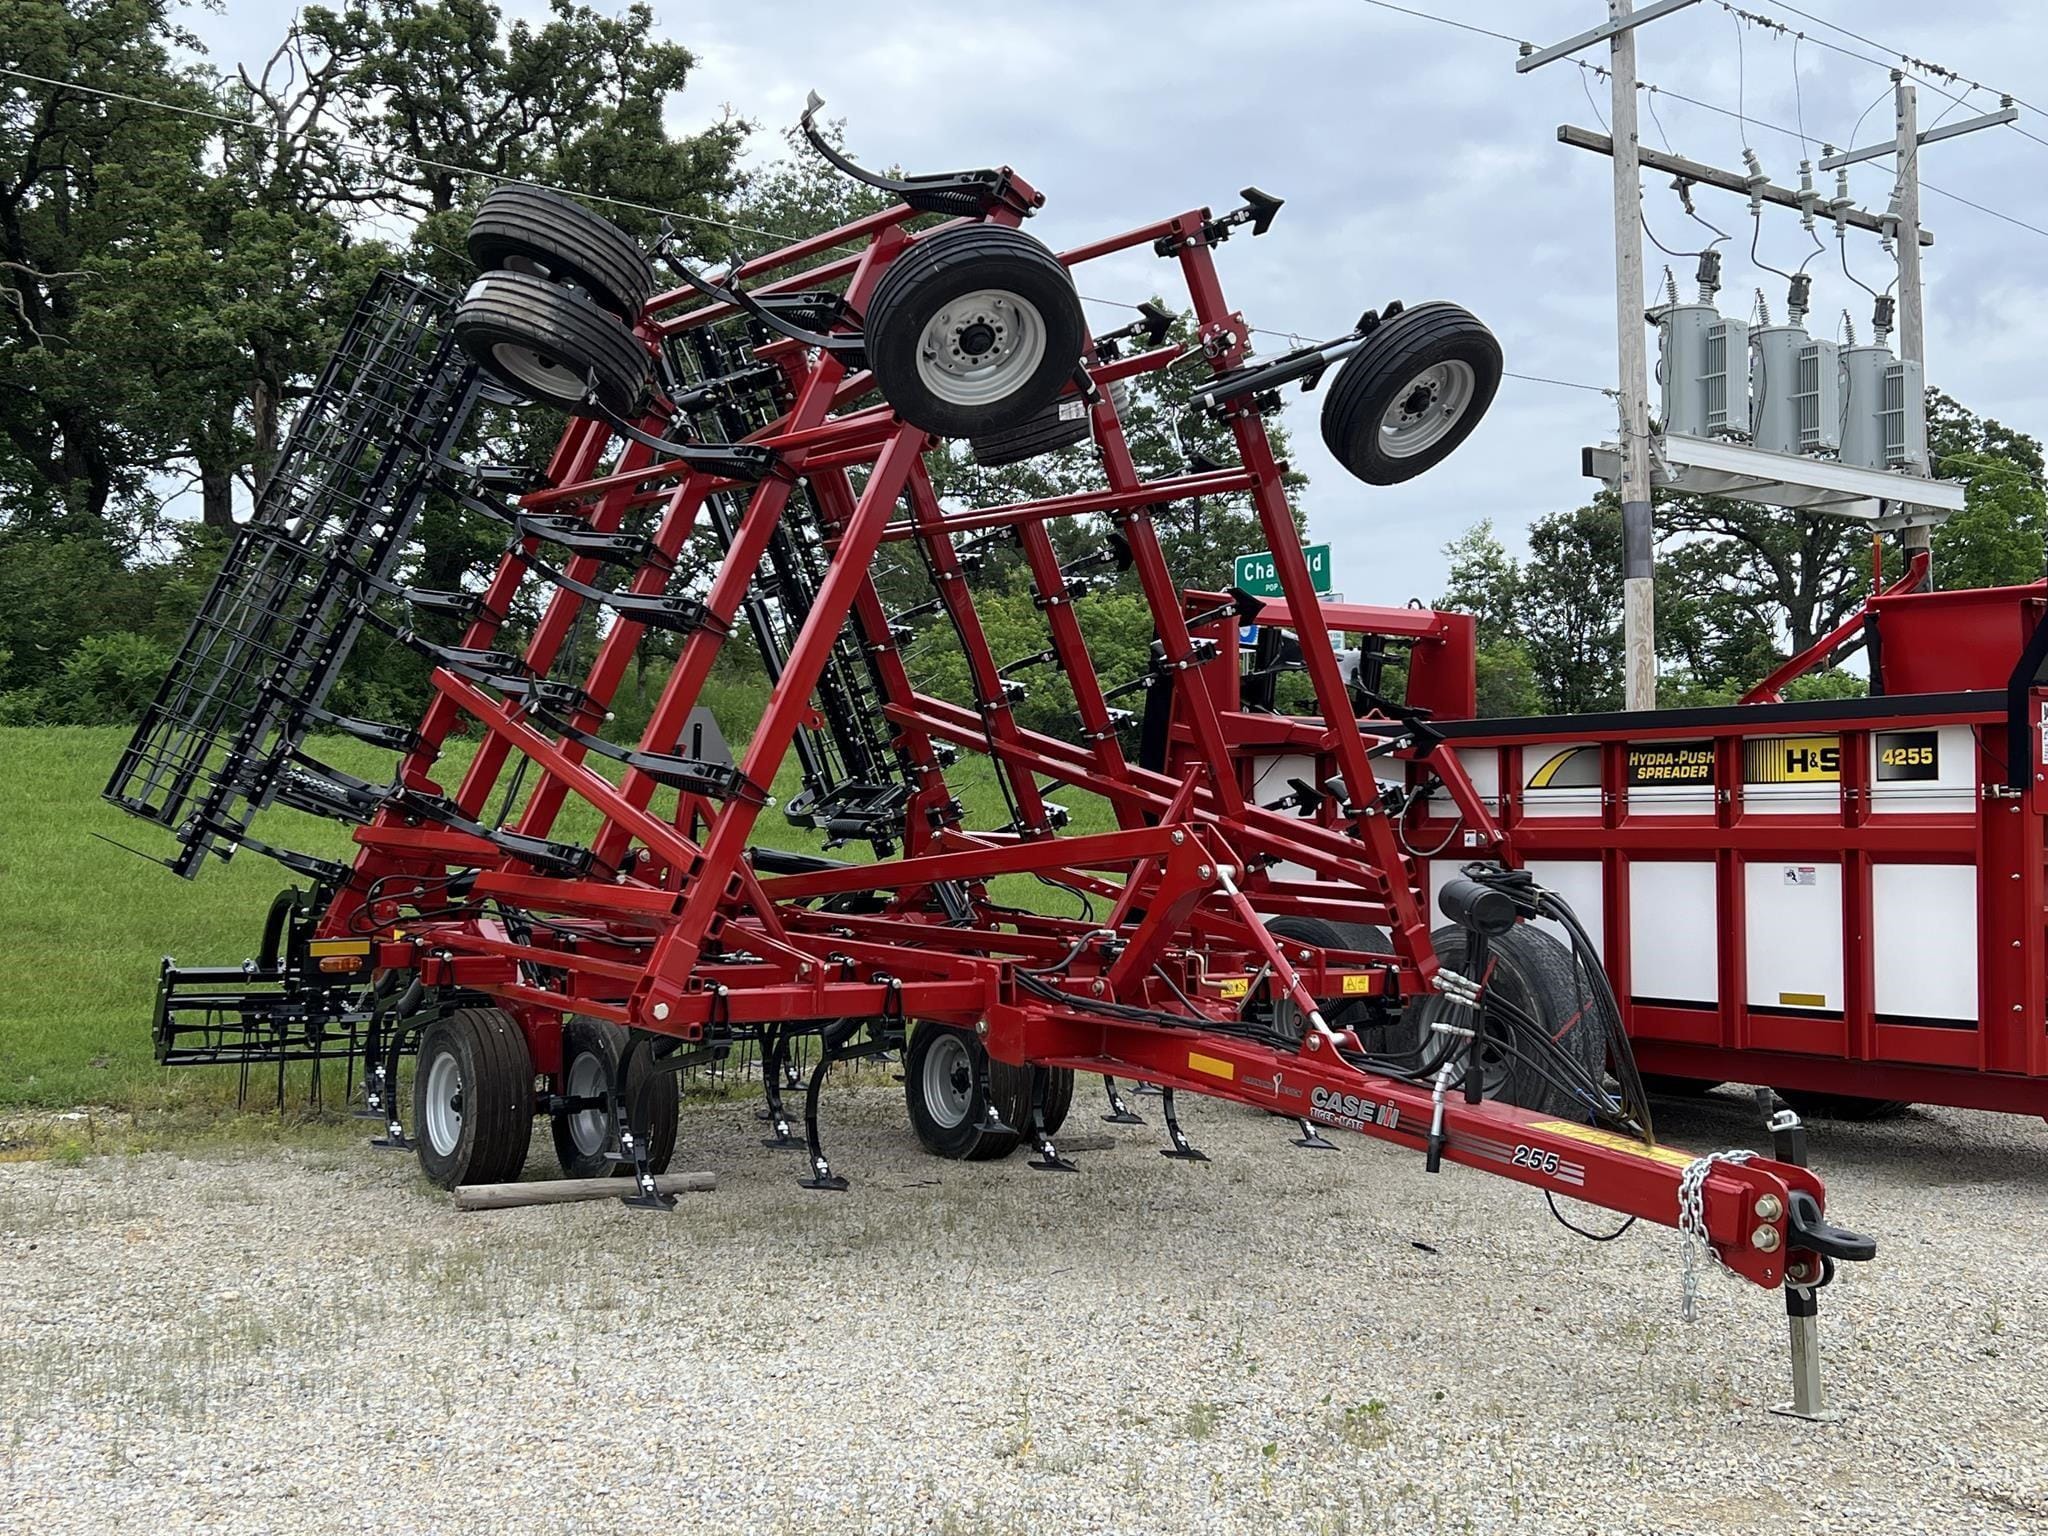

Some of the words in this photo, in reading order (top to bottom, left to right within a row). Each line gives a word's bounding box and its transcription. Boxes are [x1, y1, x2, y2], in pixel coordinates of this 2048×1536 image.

[1244, 553, 1322, 581] Chald
[1265, 583, 1279, 592] POP
[1629, 750, 1715, 766] HYDRA-PUSH
[1786, 748, 1841, 773] H&S
[1881, 747, 1933, 766] 4255
[1637, 765, 1708, 779] SPREADER
[1310, 1086, 1376, 1121] CASE
[1512, 1144, 1560, 1175] 255
